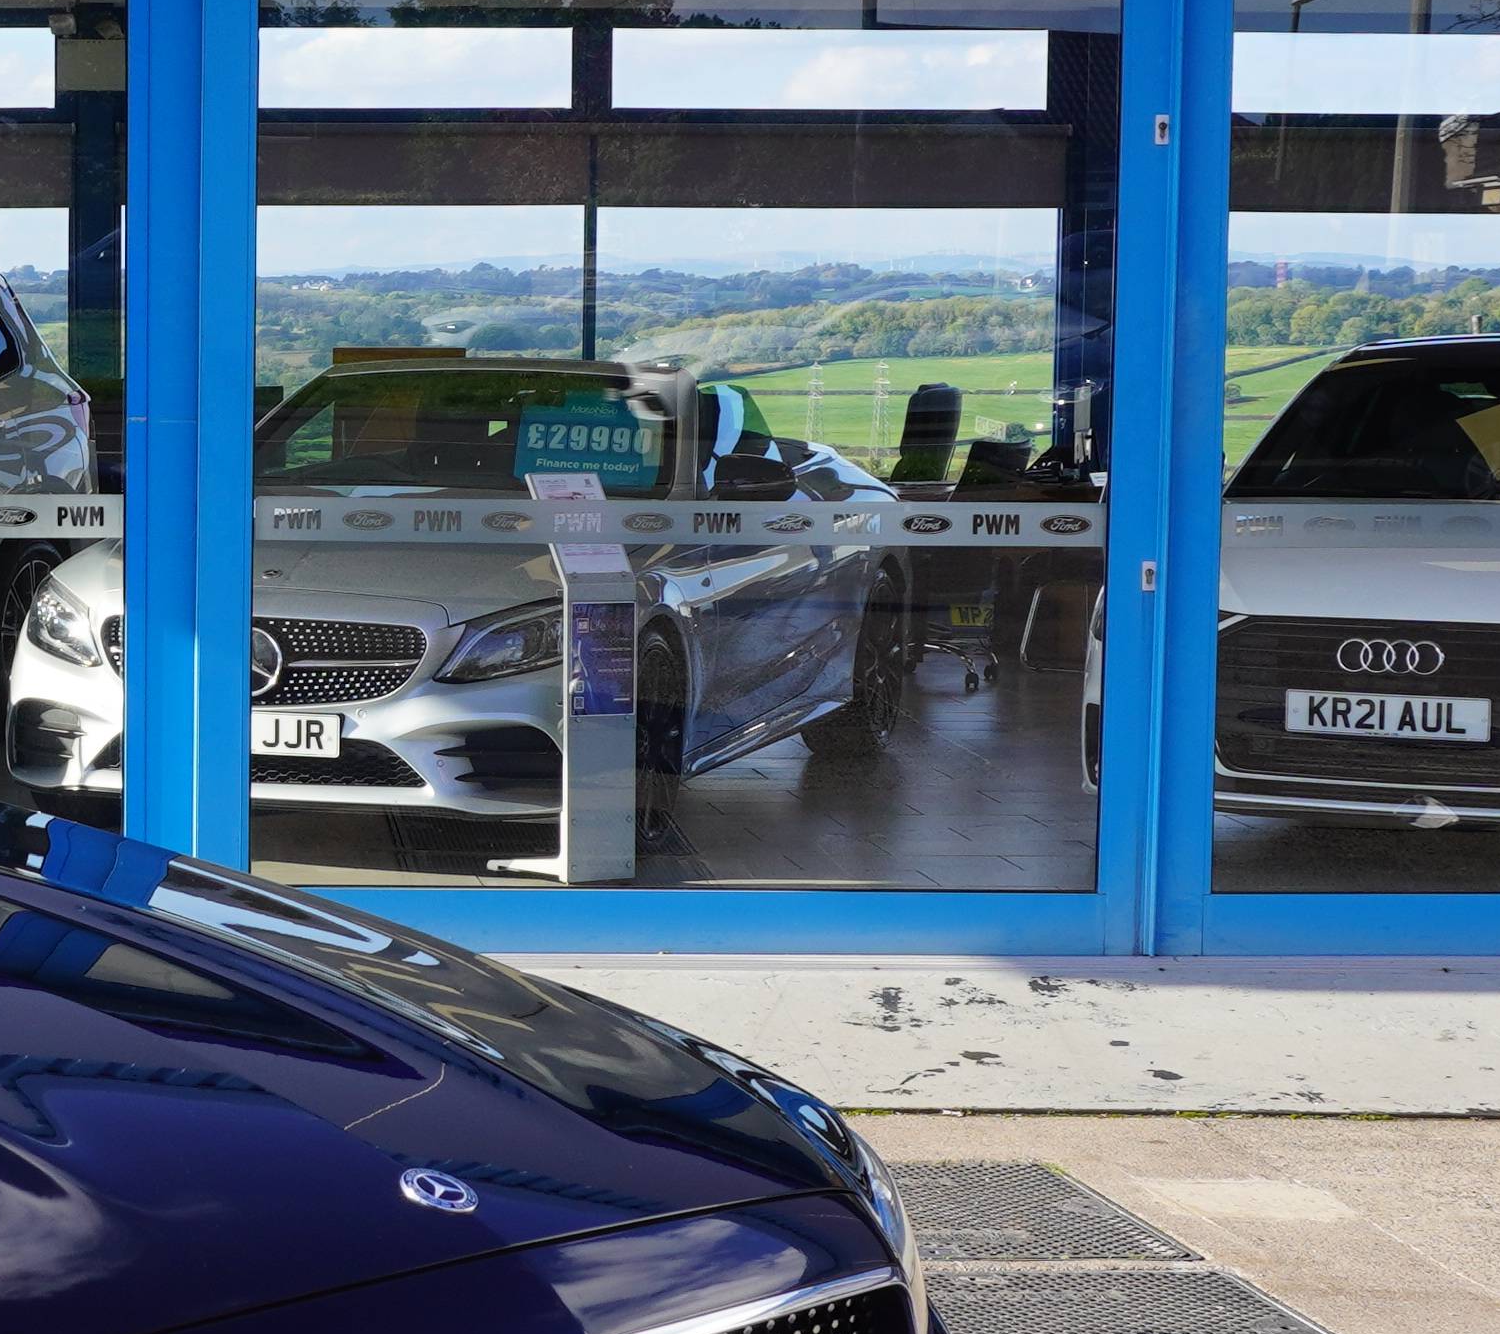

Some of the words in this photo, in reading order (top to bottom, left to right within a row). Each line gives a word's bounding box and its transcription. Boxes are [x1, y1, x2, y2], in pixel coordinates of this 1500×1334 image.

[527, 423, 653, 455] £29990
[536, 457, 580, 470] Finance
[582, 461, 600, 470] me
[602, 461, 640, 475] today!
[57, 506, 105, 527] PWM
[273, 507, 322, 531] PWM
[346, 510, 391, 530] Ford
[413, 510, 462, 533] PWM
[553, 511, 602, 534] PWM
[626, 512, 670, 532] Ford
[693, 512, 742, 535] PWM
[833, 513, 882, 536] PWM
[905, 514, 950, 534] Ford
[972, 513, 1020, 536] PWM
[1043, 515, 1088, 535] Ford
[1308, 695, 1386, 730] KR21
[1397, 700, 1467, 735] AUL
[262, 718, 325, 750] JJR
